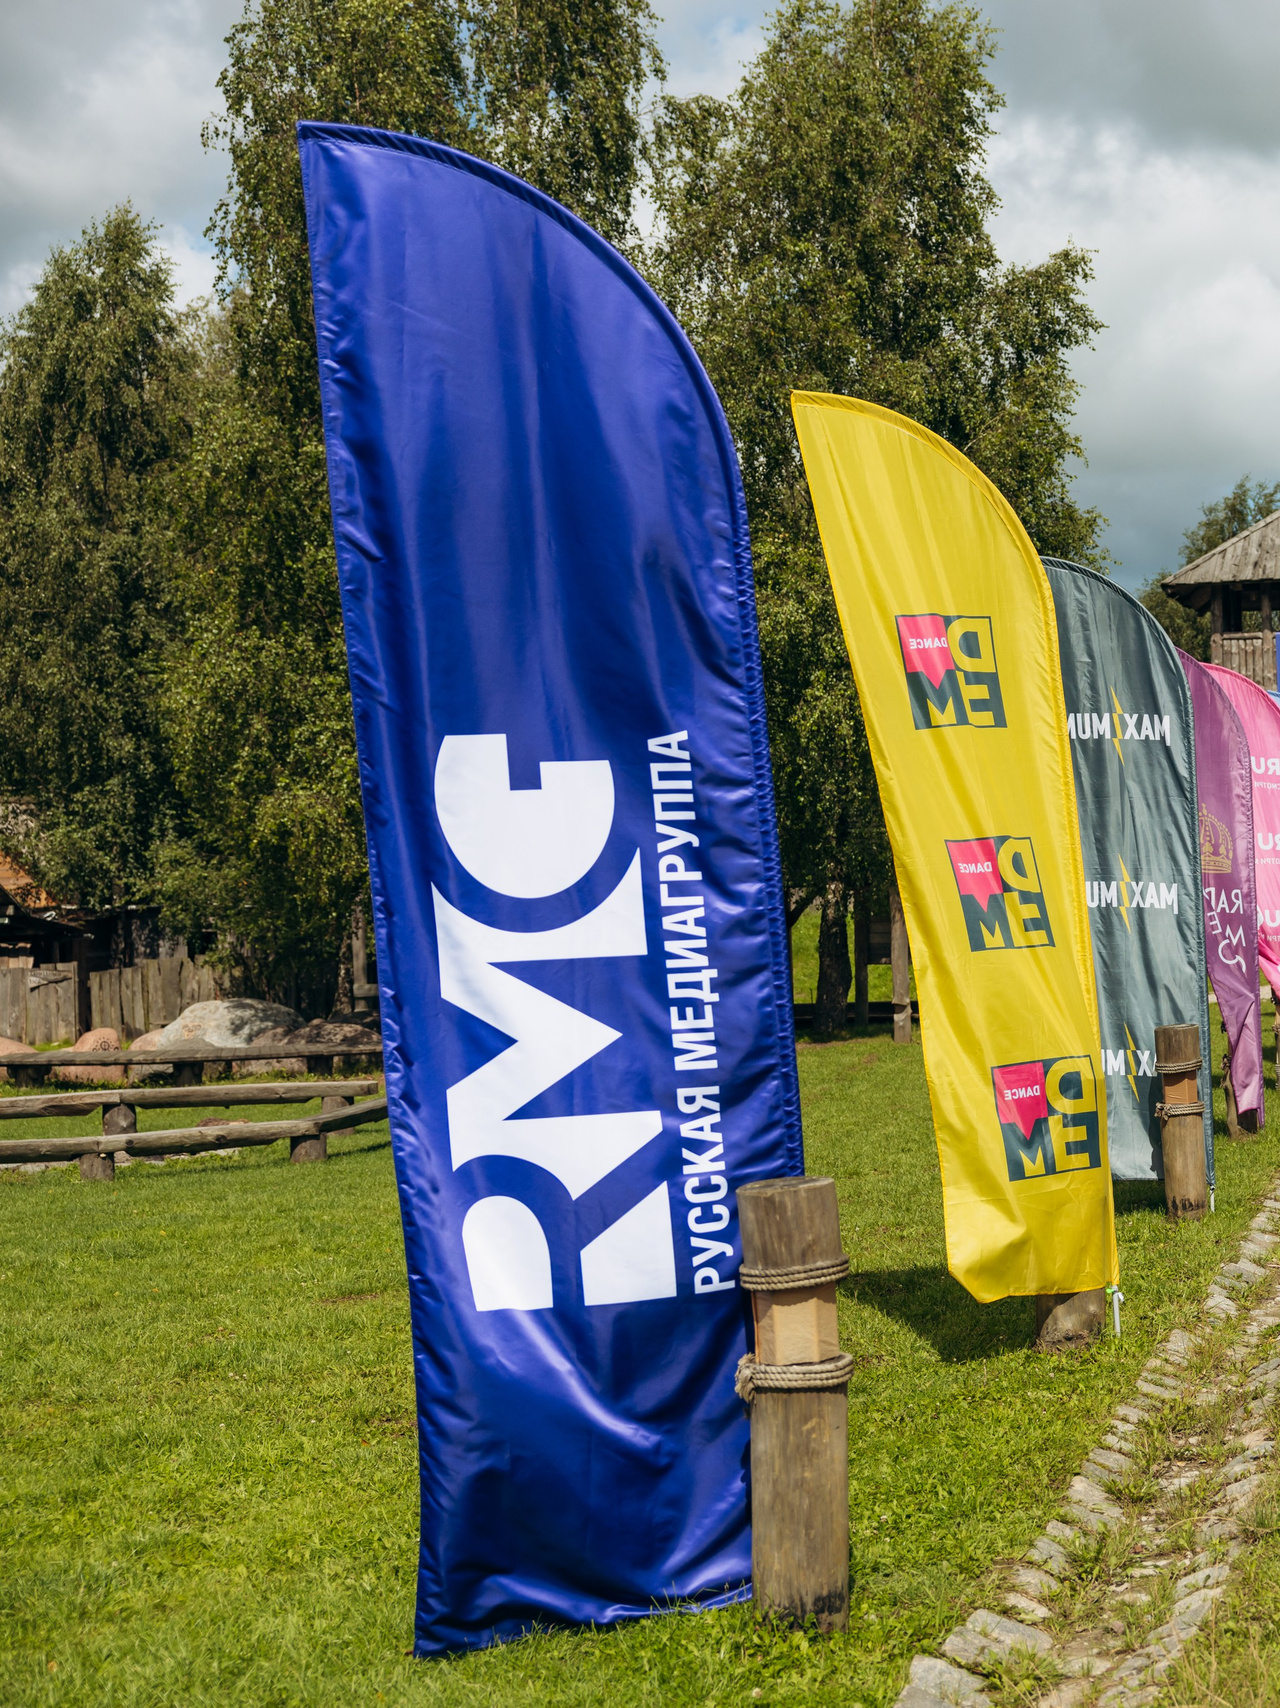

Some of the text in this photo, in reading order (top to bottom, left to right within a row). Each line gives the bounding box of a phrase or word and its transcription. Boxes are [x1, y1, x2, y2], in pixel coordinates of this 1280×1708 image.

[431, 733, 678, 1311] RMG
[647, 730, 736, 1295] РУССКАЯ МЕДИАГРУППА
